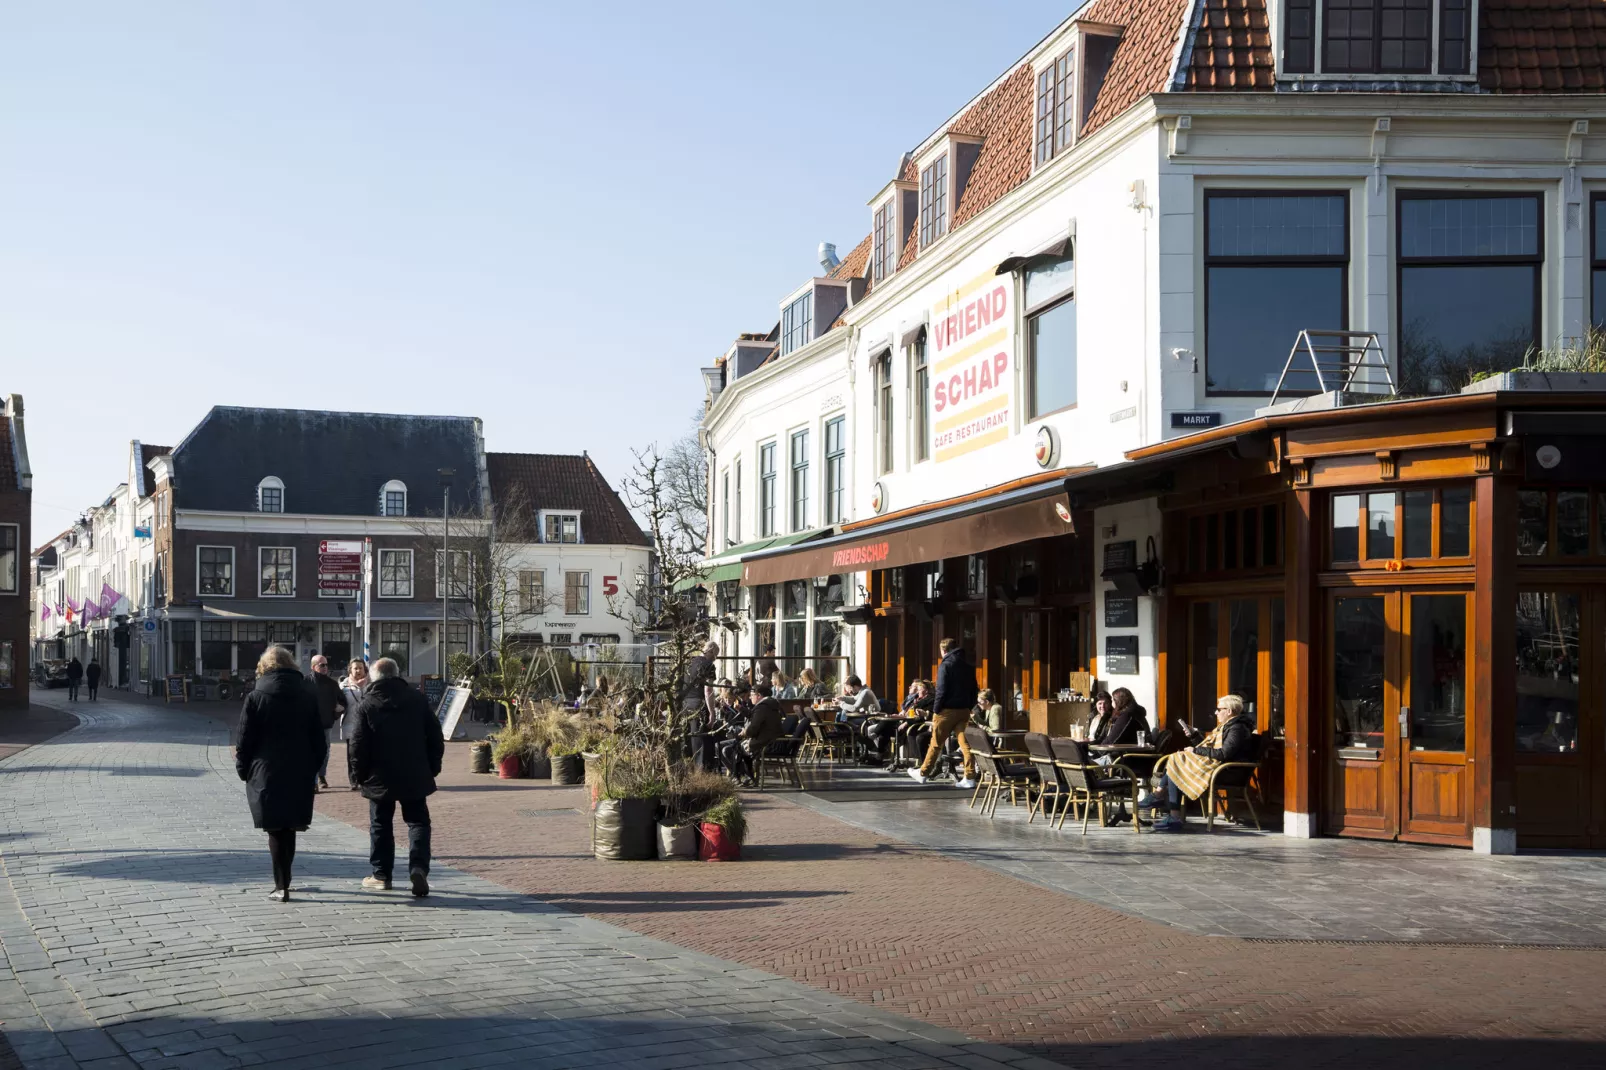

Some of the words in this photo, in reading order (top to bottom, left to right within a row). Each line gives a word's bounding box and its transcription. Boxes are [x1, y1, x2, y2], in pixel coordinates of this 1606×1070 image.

[934, 285, 1007, 352] VRIEND
[934, 352, 1008, 413] SCHAP
[935, 432, 953, 448] CAFE
[956, 410, 1009, 441] RESTAURANT
[1183, 415, 1211, 425] MARKT
[832, 542, 889, 567] VRIENDSCHAP
[603, 575, 619, 596] 5
